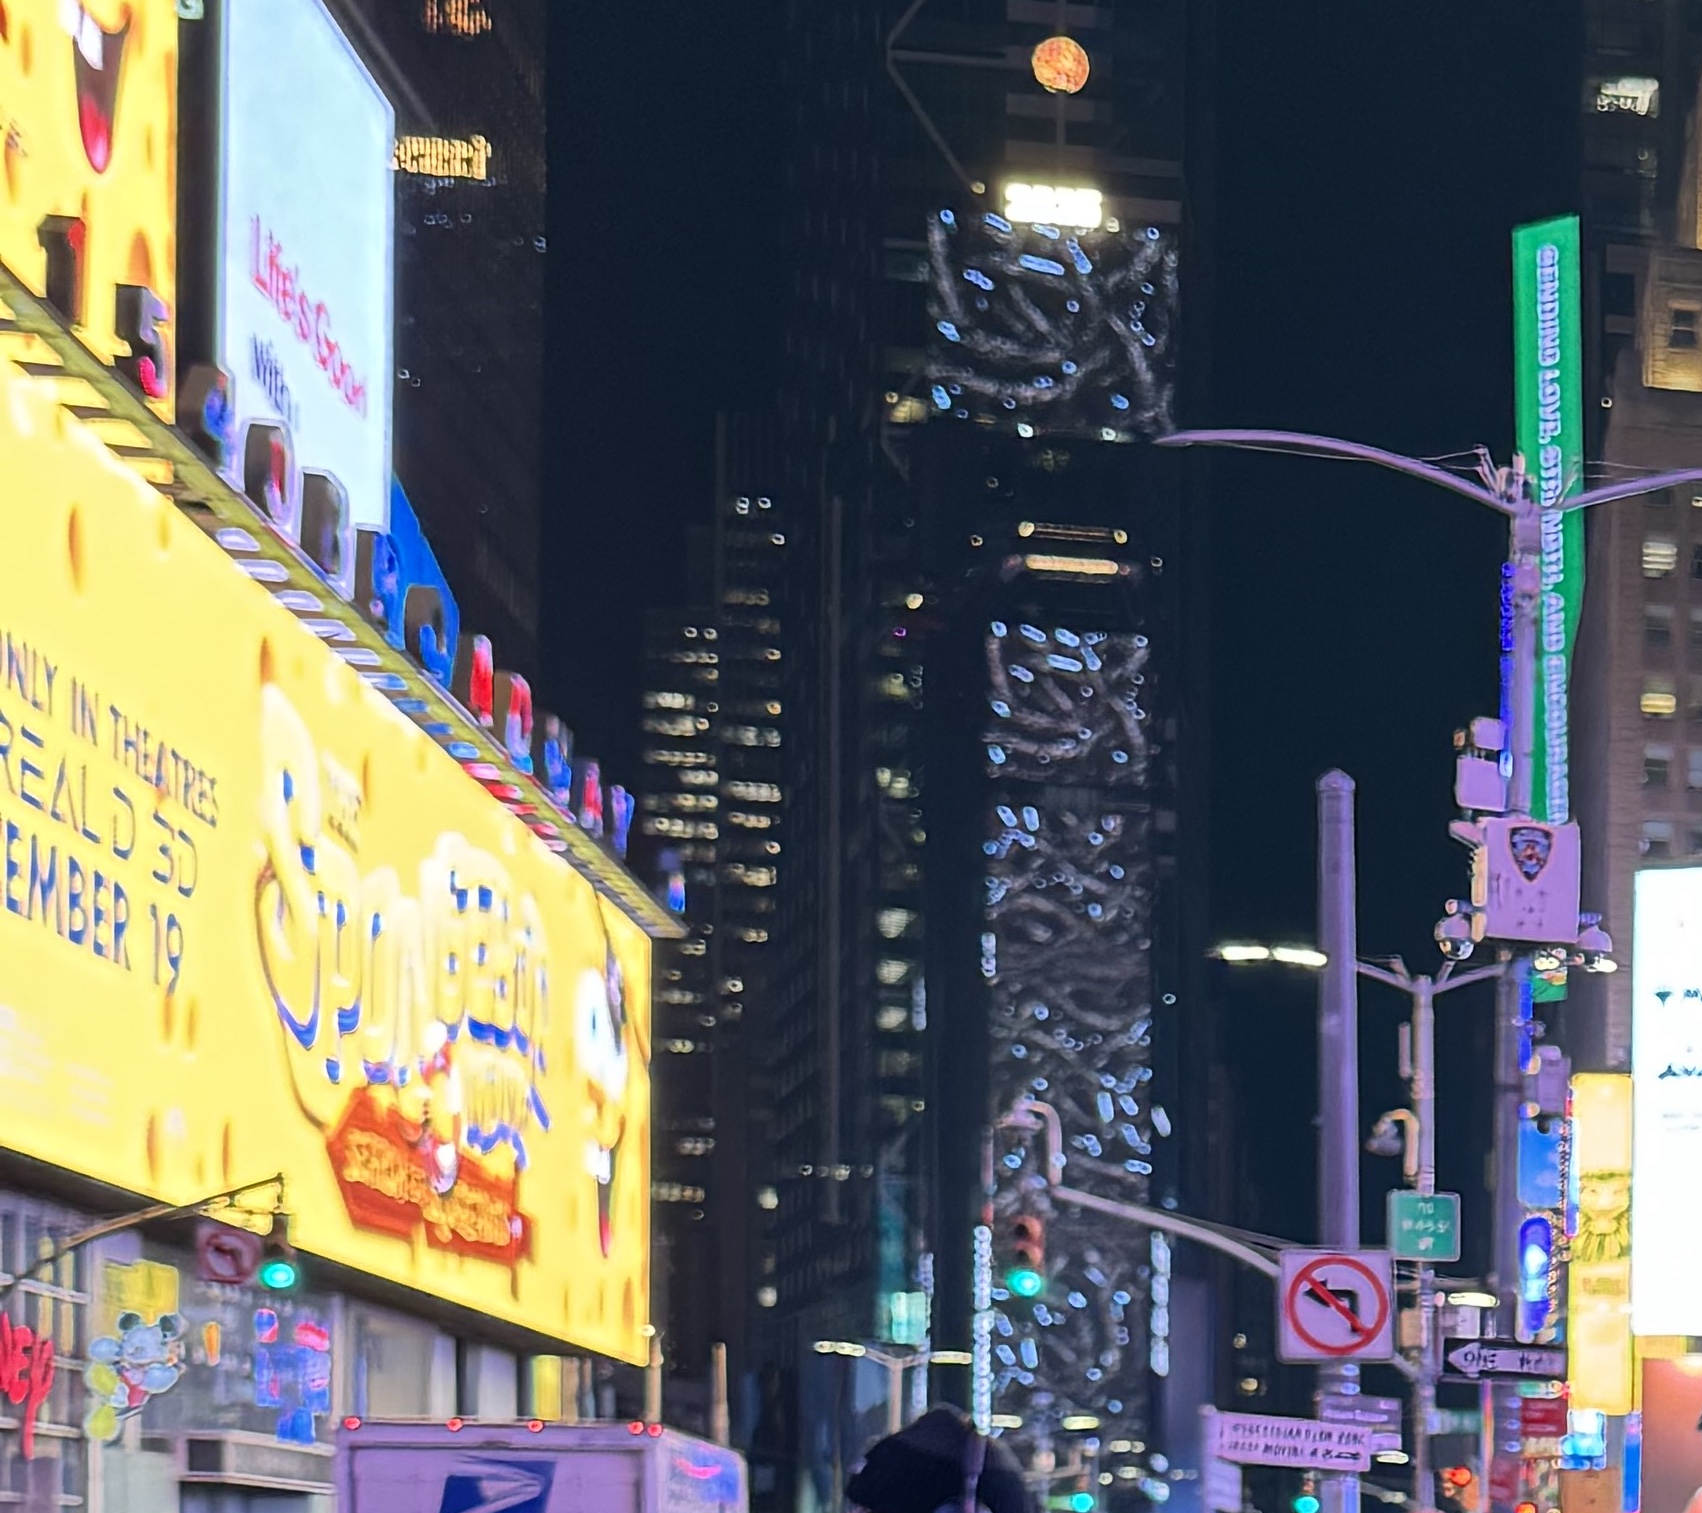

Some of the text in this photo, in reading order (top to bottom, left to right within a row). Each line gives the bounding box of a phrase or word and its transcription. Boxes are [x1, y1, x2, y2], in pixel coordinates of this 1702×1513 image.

[0, 629, 58, 717] NLY
[71, 675, 99, 746] IN
[0, 818, 184, 997] EMBER 19
